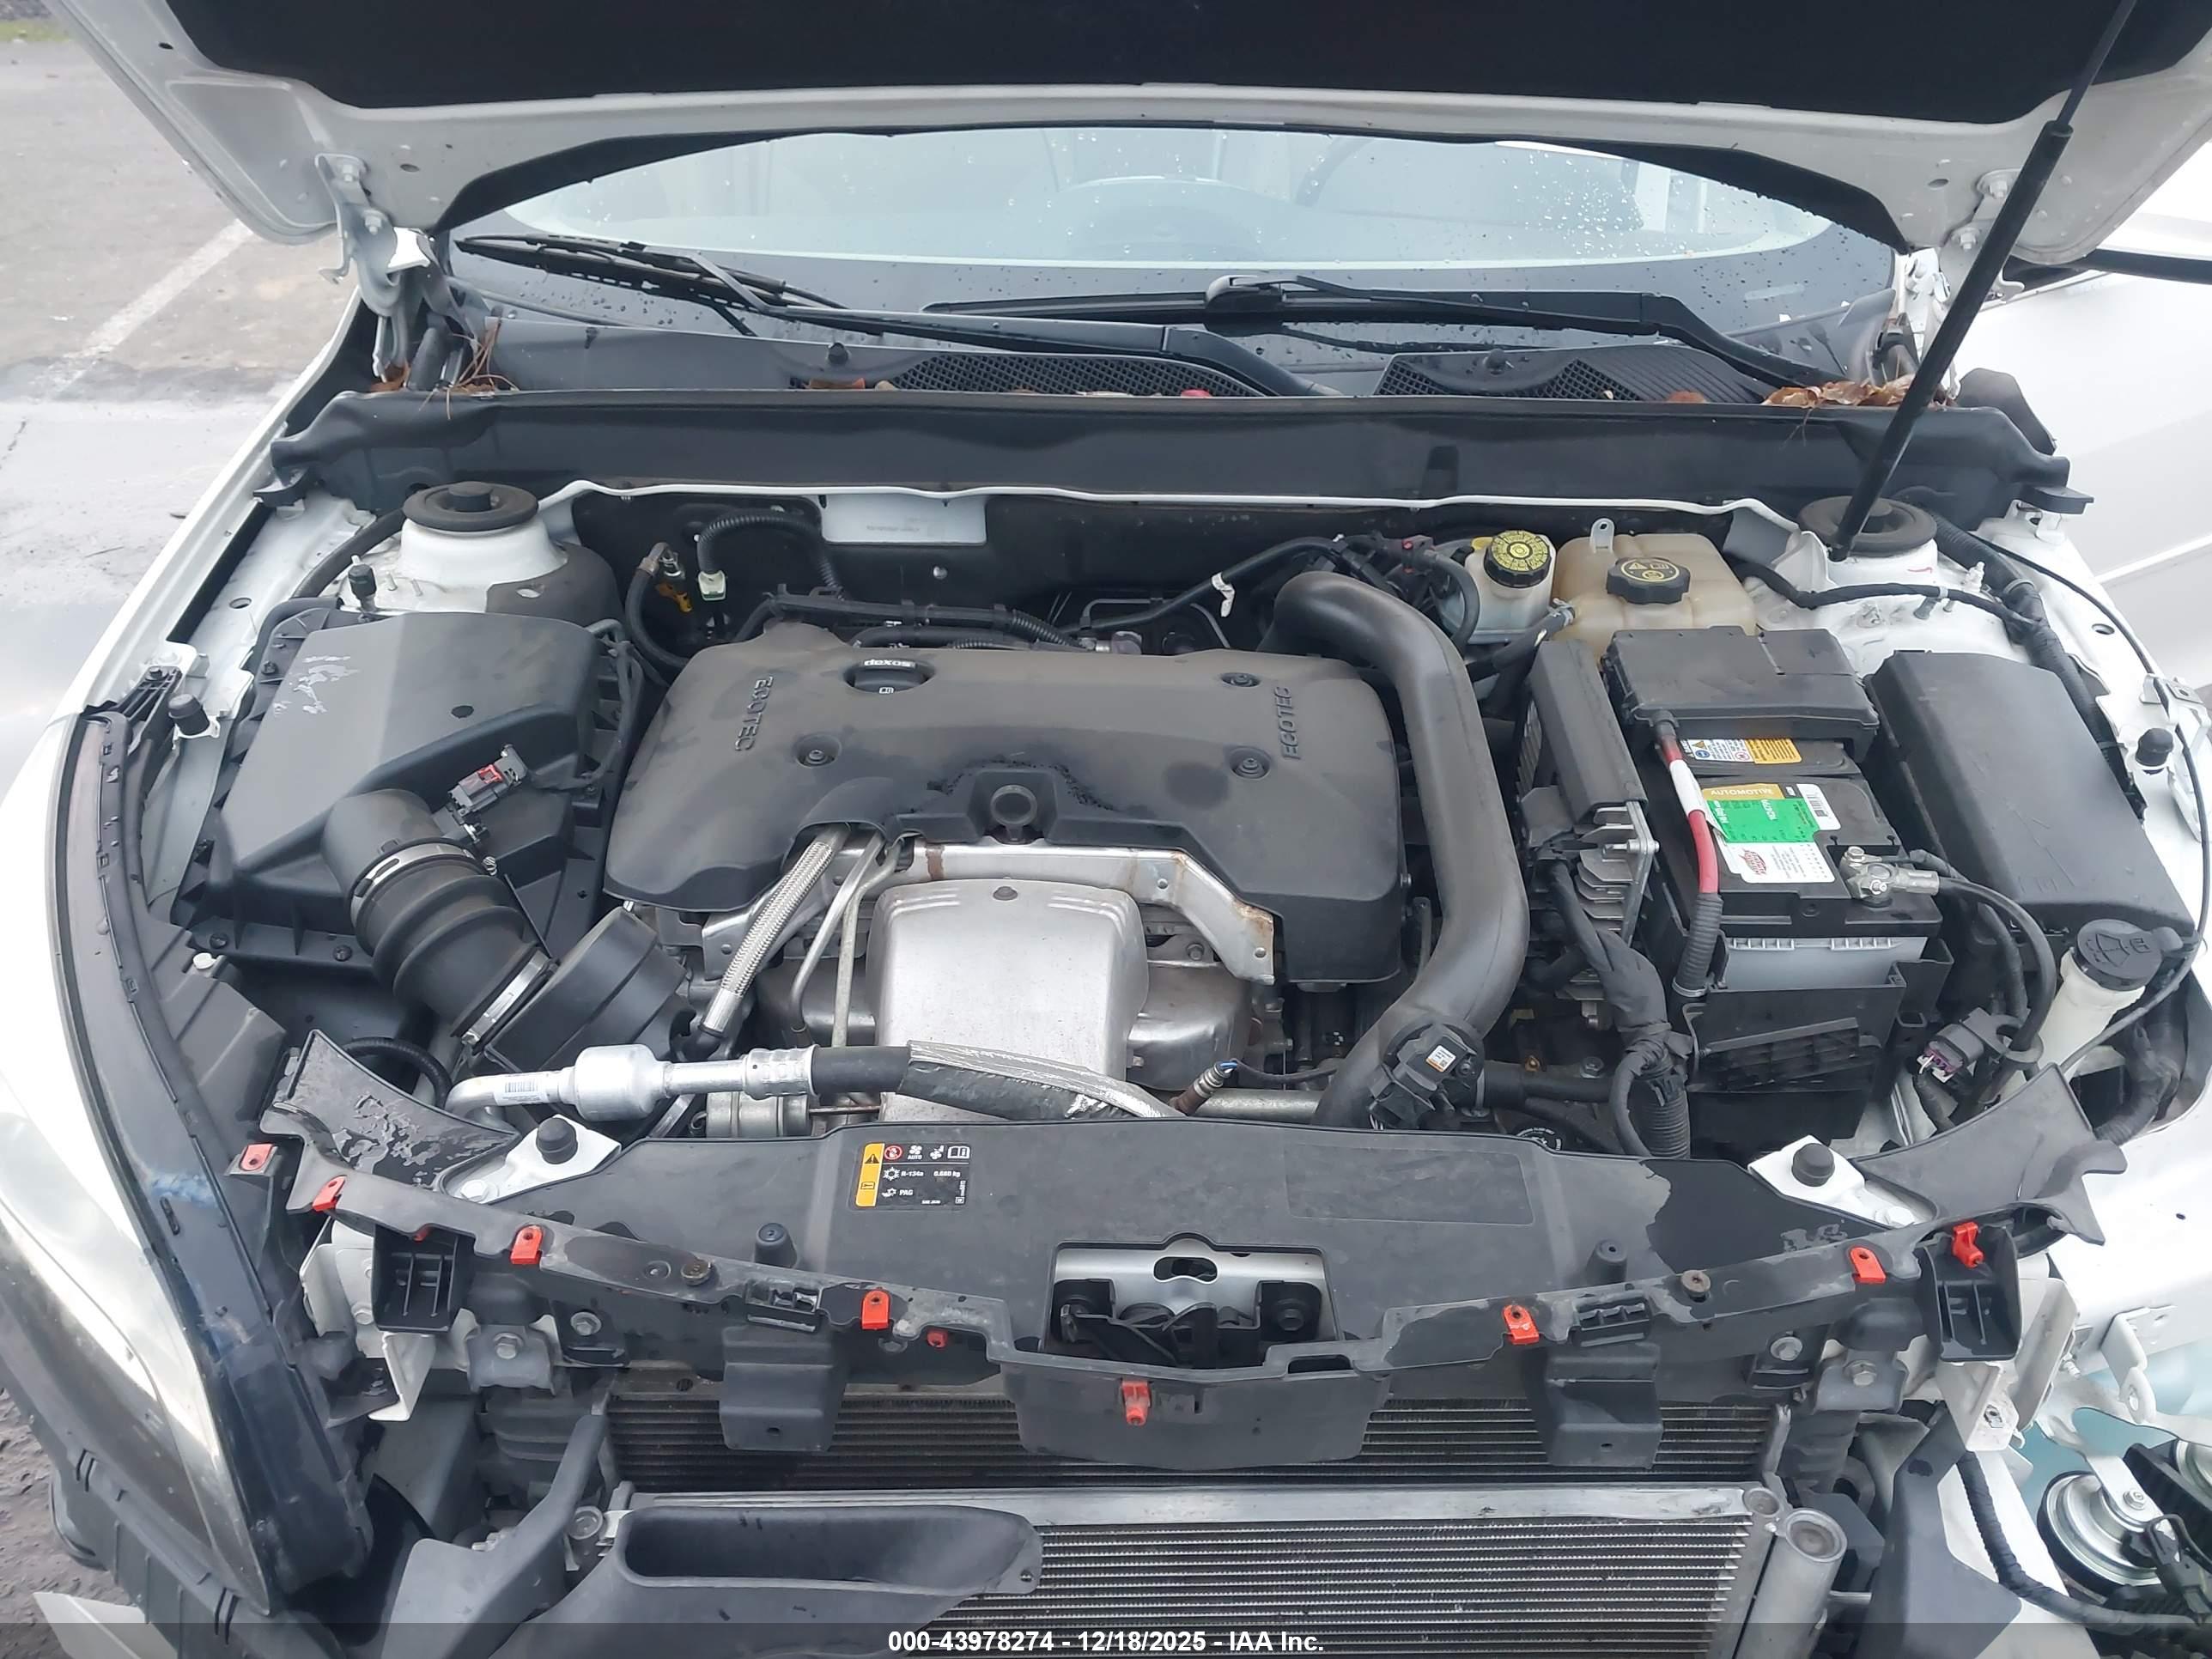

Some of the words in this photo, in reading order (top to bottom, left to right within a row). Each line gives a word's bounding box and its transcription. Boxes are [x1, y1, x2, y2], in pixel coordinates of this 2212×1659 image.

[864, 659, 913, 667] dexos
[734, 676, 774, 752] ECOTEC
[1274, 686, 1301, 760] ECOTEC
